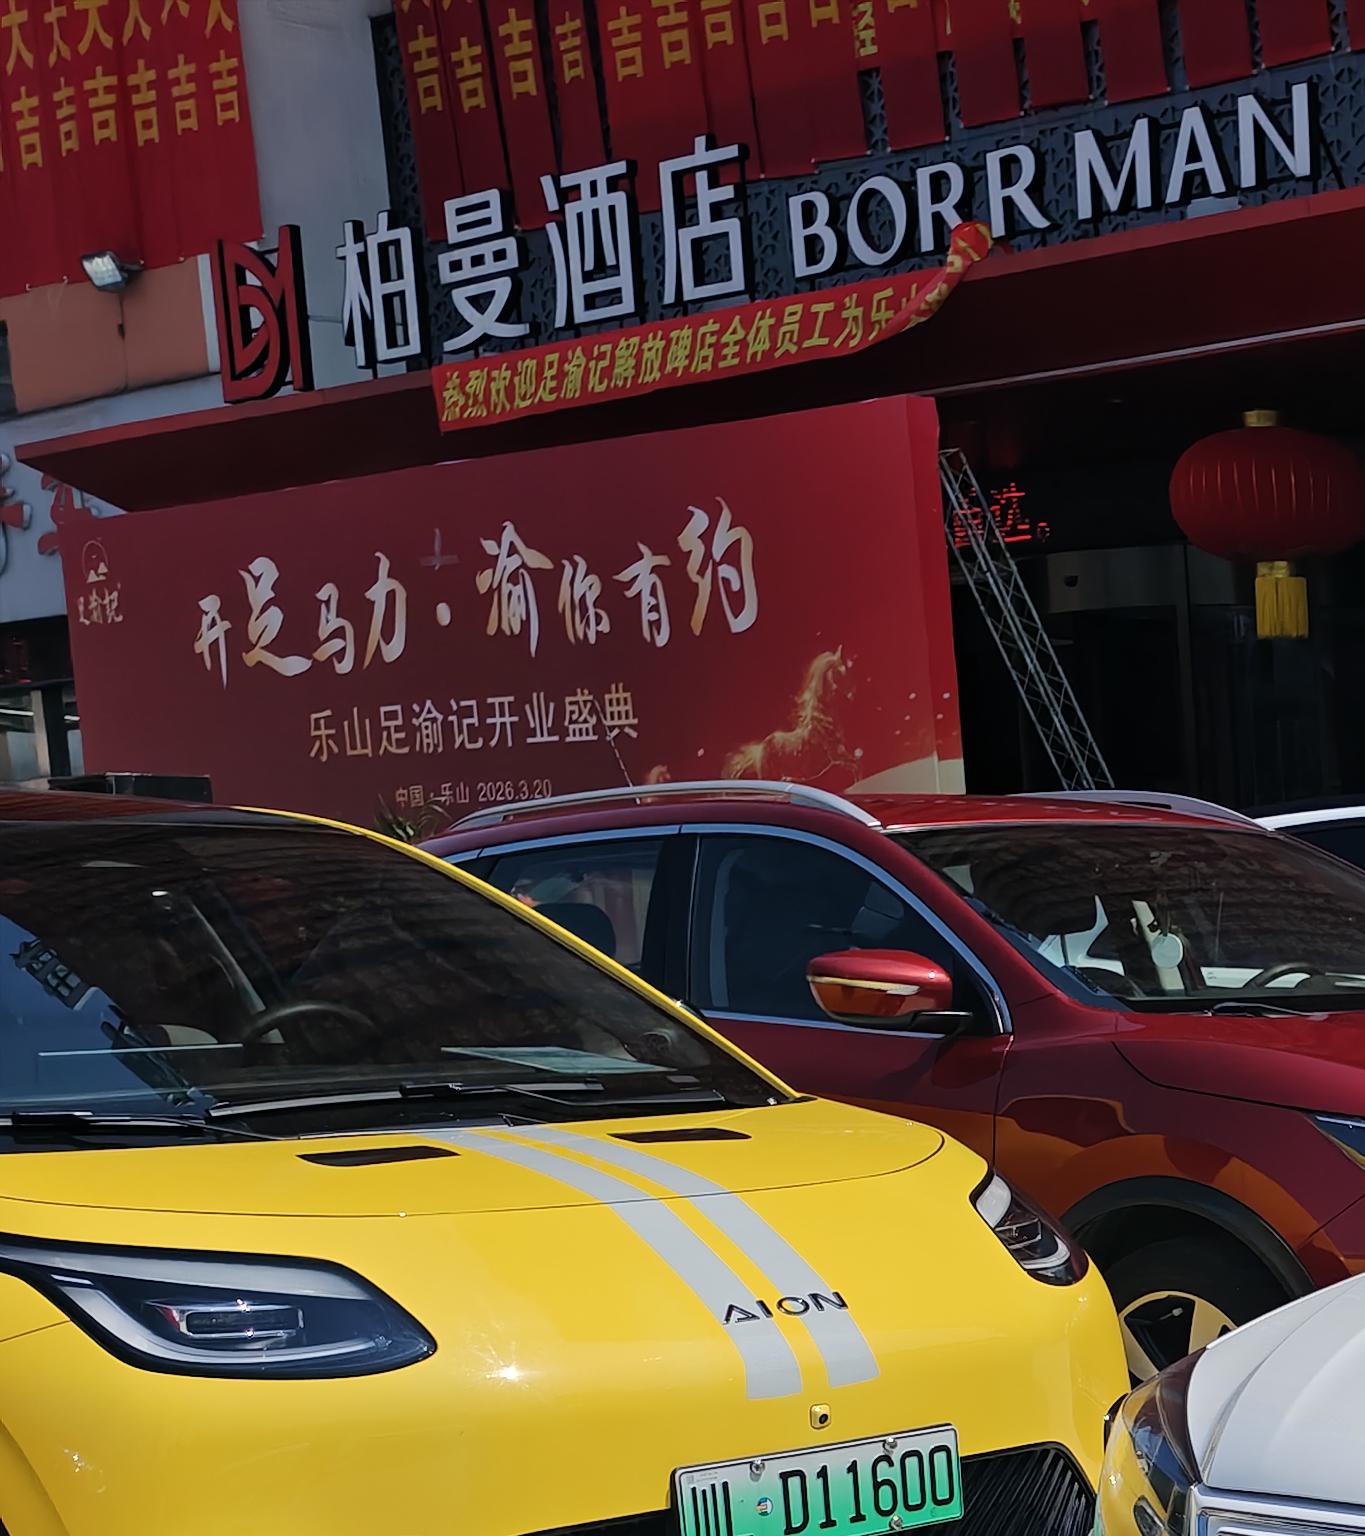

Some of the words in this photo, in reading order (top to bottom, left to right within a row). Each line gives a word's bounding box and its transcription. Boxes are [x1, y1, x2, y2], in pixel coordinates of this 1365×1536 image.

[334, 135, 751, 368] 柏曼酒店
[308, 682, 640, 763] 乐山足渝记开业盛典
[476, 778, 552, 802] 2026.3.20
[722, 1290, 849, 1326] AION
